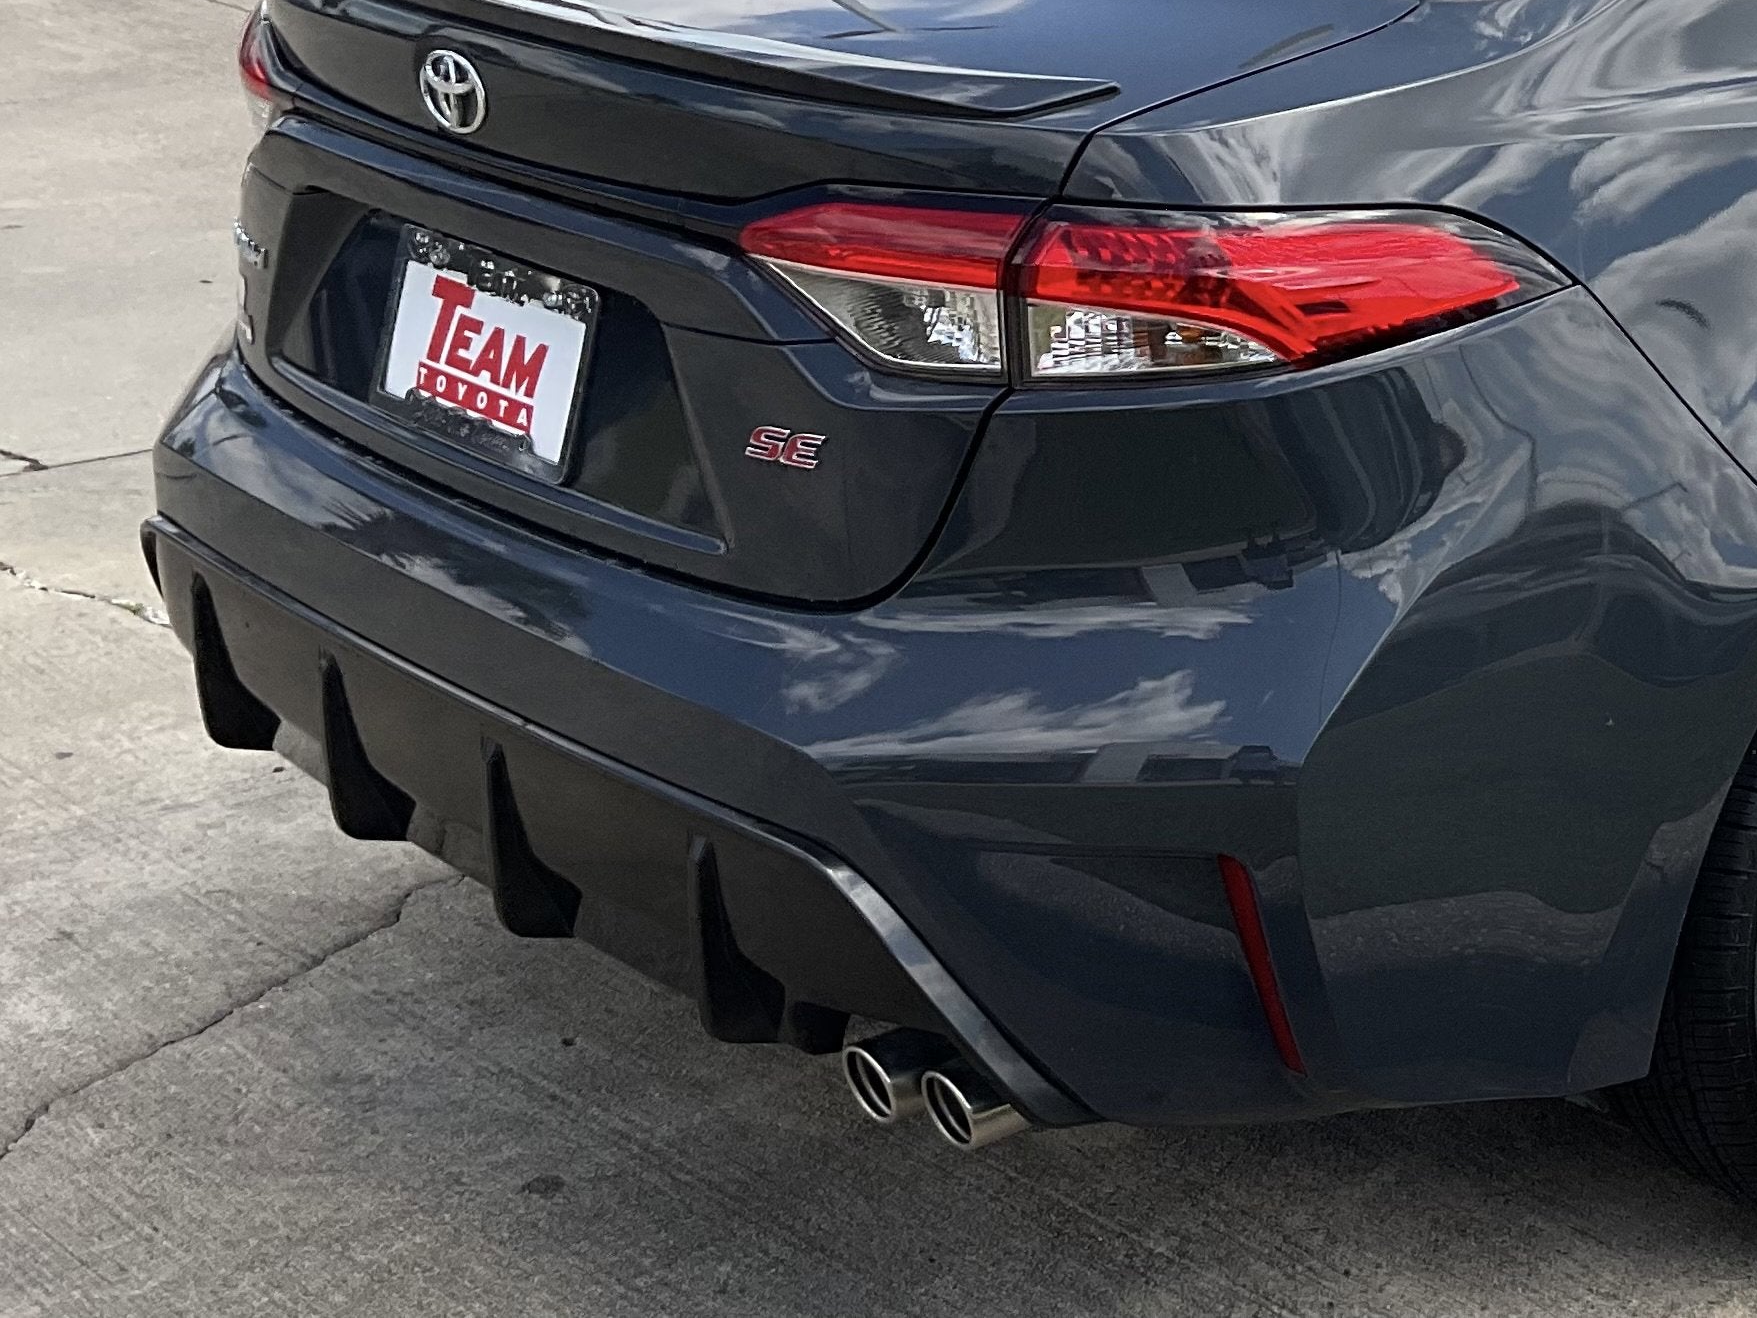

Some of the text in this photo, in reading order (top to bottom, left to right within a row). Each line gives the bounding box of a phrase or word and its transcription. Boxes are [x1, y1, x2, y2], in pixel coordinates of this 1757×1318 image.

[431, 273, 550, 399] TEAM
[418, 365, 530, 427] TOYOTA
[744, 425, 826, 470] SE
